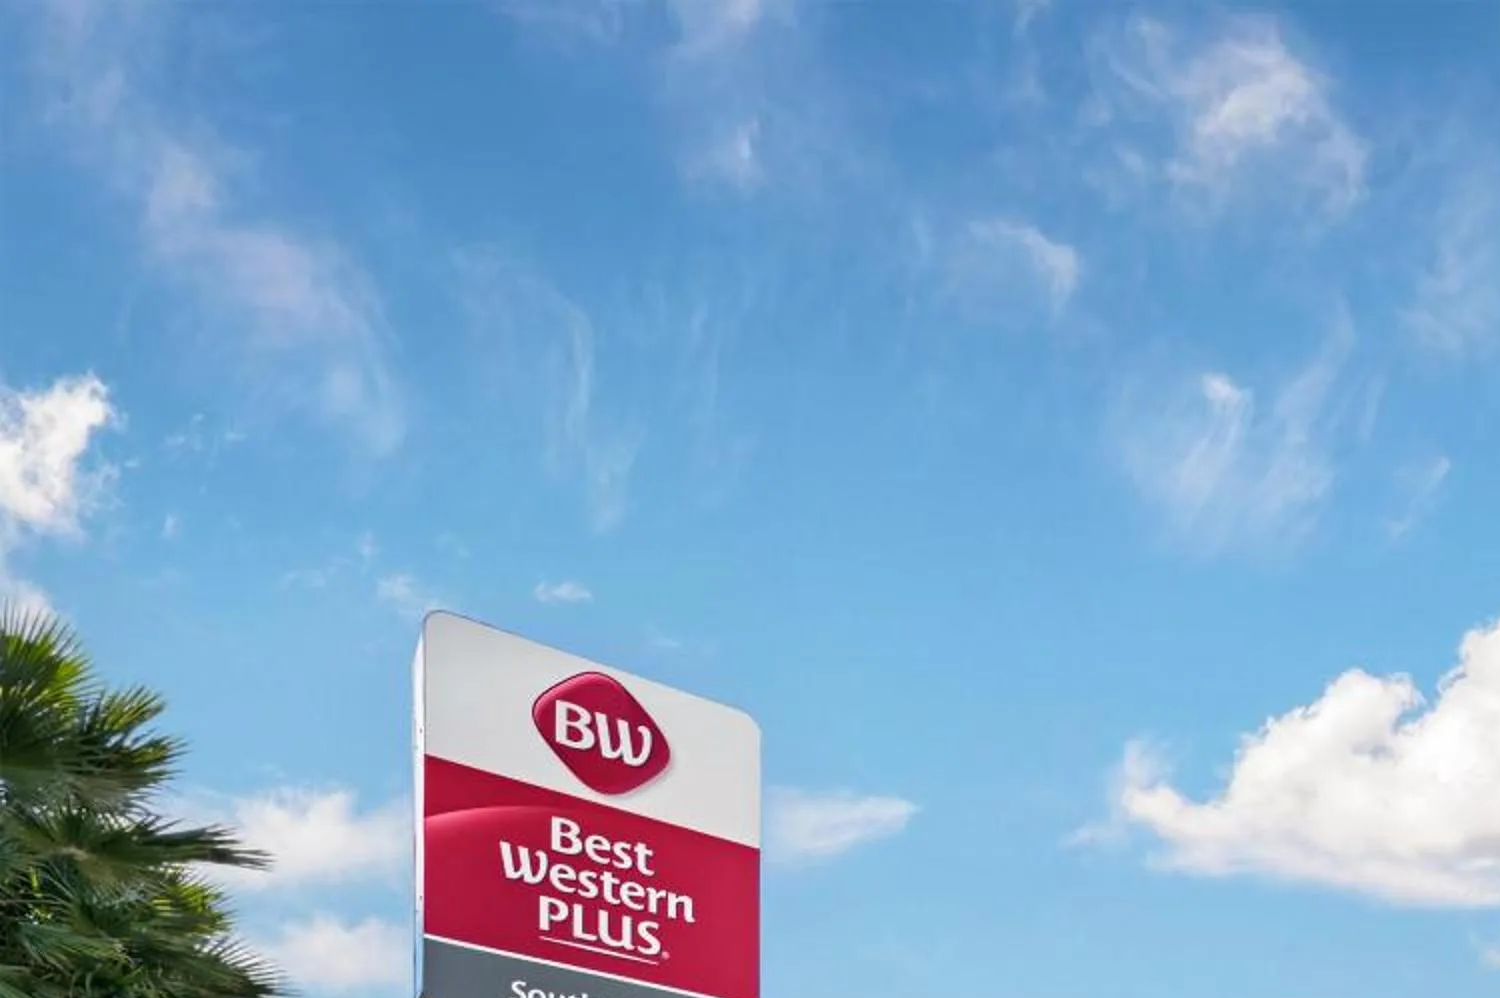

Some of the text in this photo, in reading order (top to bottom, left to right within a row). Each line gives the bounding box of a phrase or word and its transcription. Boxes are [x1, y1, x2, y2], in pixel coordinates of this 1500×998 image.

[555, 699, 653, 767] BW
[550, 815, 655, 877] Best
[499, 841, 696, 923] Western
[538, 895, 662, 956] PLUS
